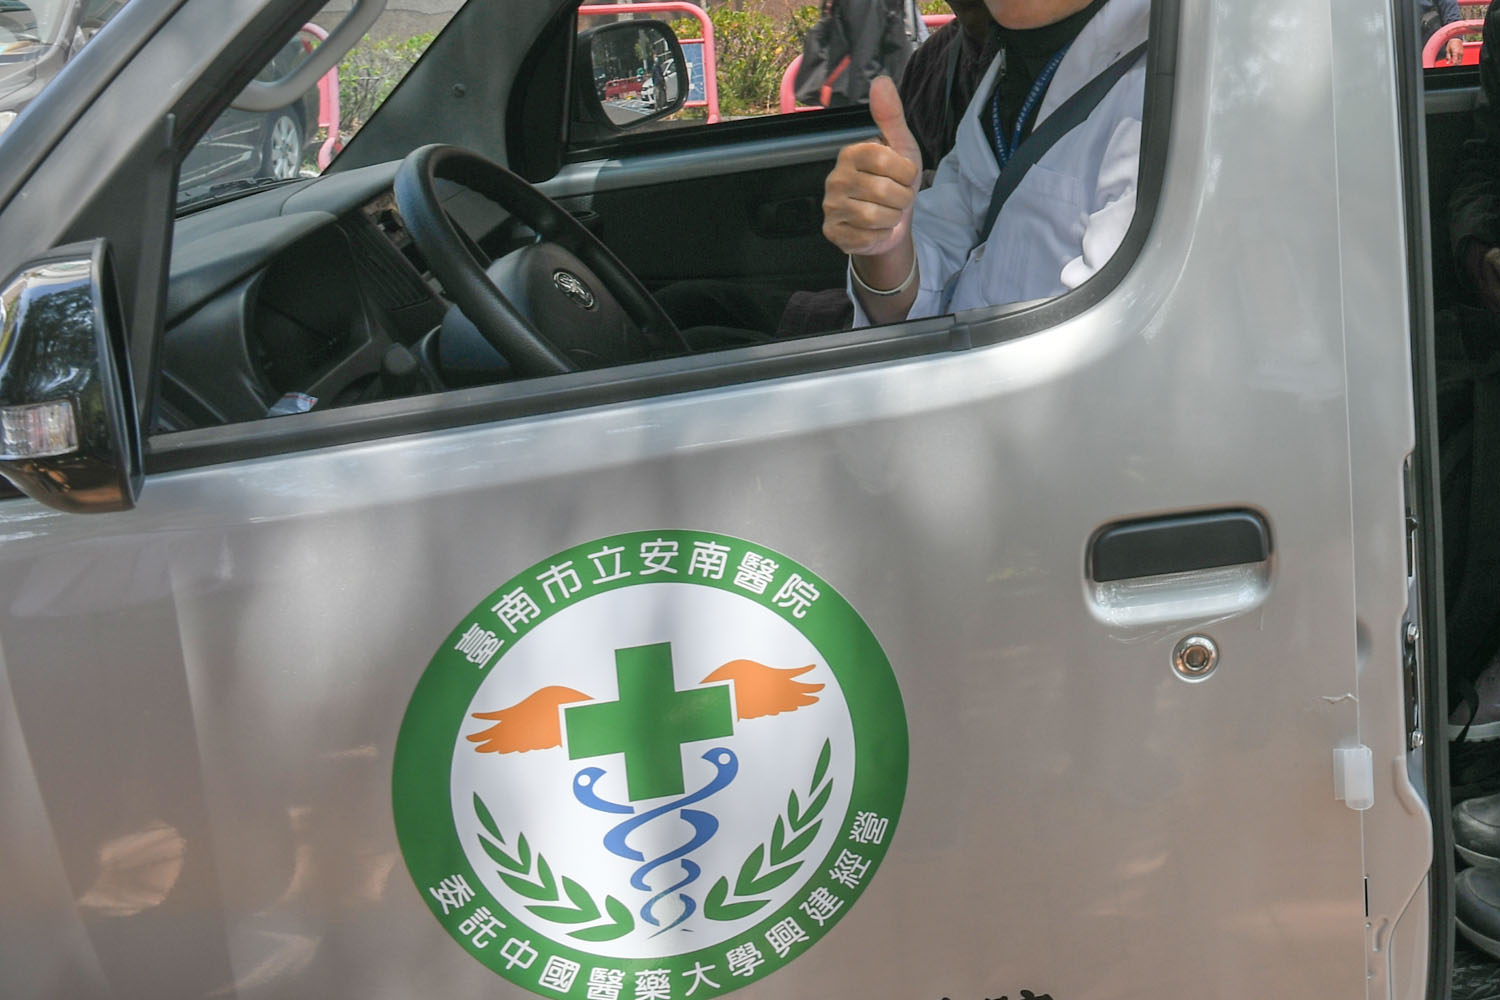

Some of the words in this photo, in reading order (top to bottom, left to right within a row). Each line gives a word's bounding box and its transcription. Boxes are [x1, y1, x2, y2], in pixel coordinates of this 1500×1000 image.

[453, 538, 821, 669] 臺南市立安南醫院
[428, 811, 891, 1000] 委託中國醫藥大學興建經營
